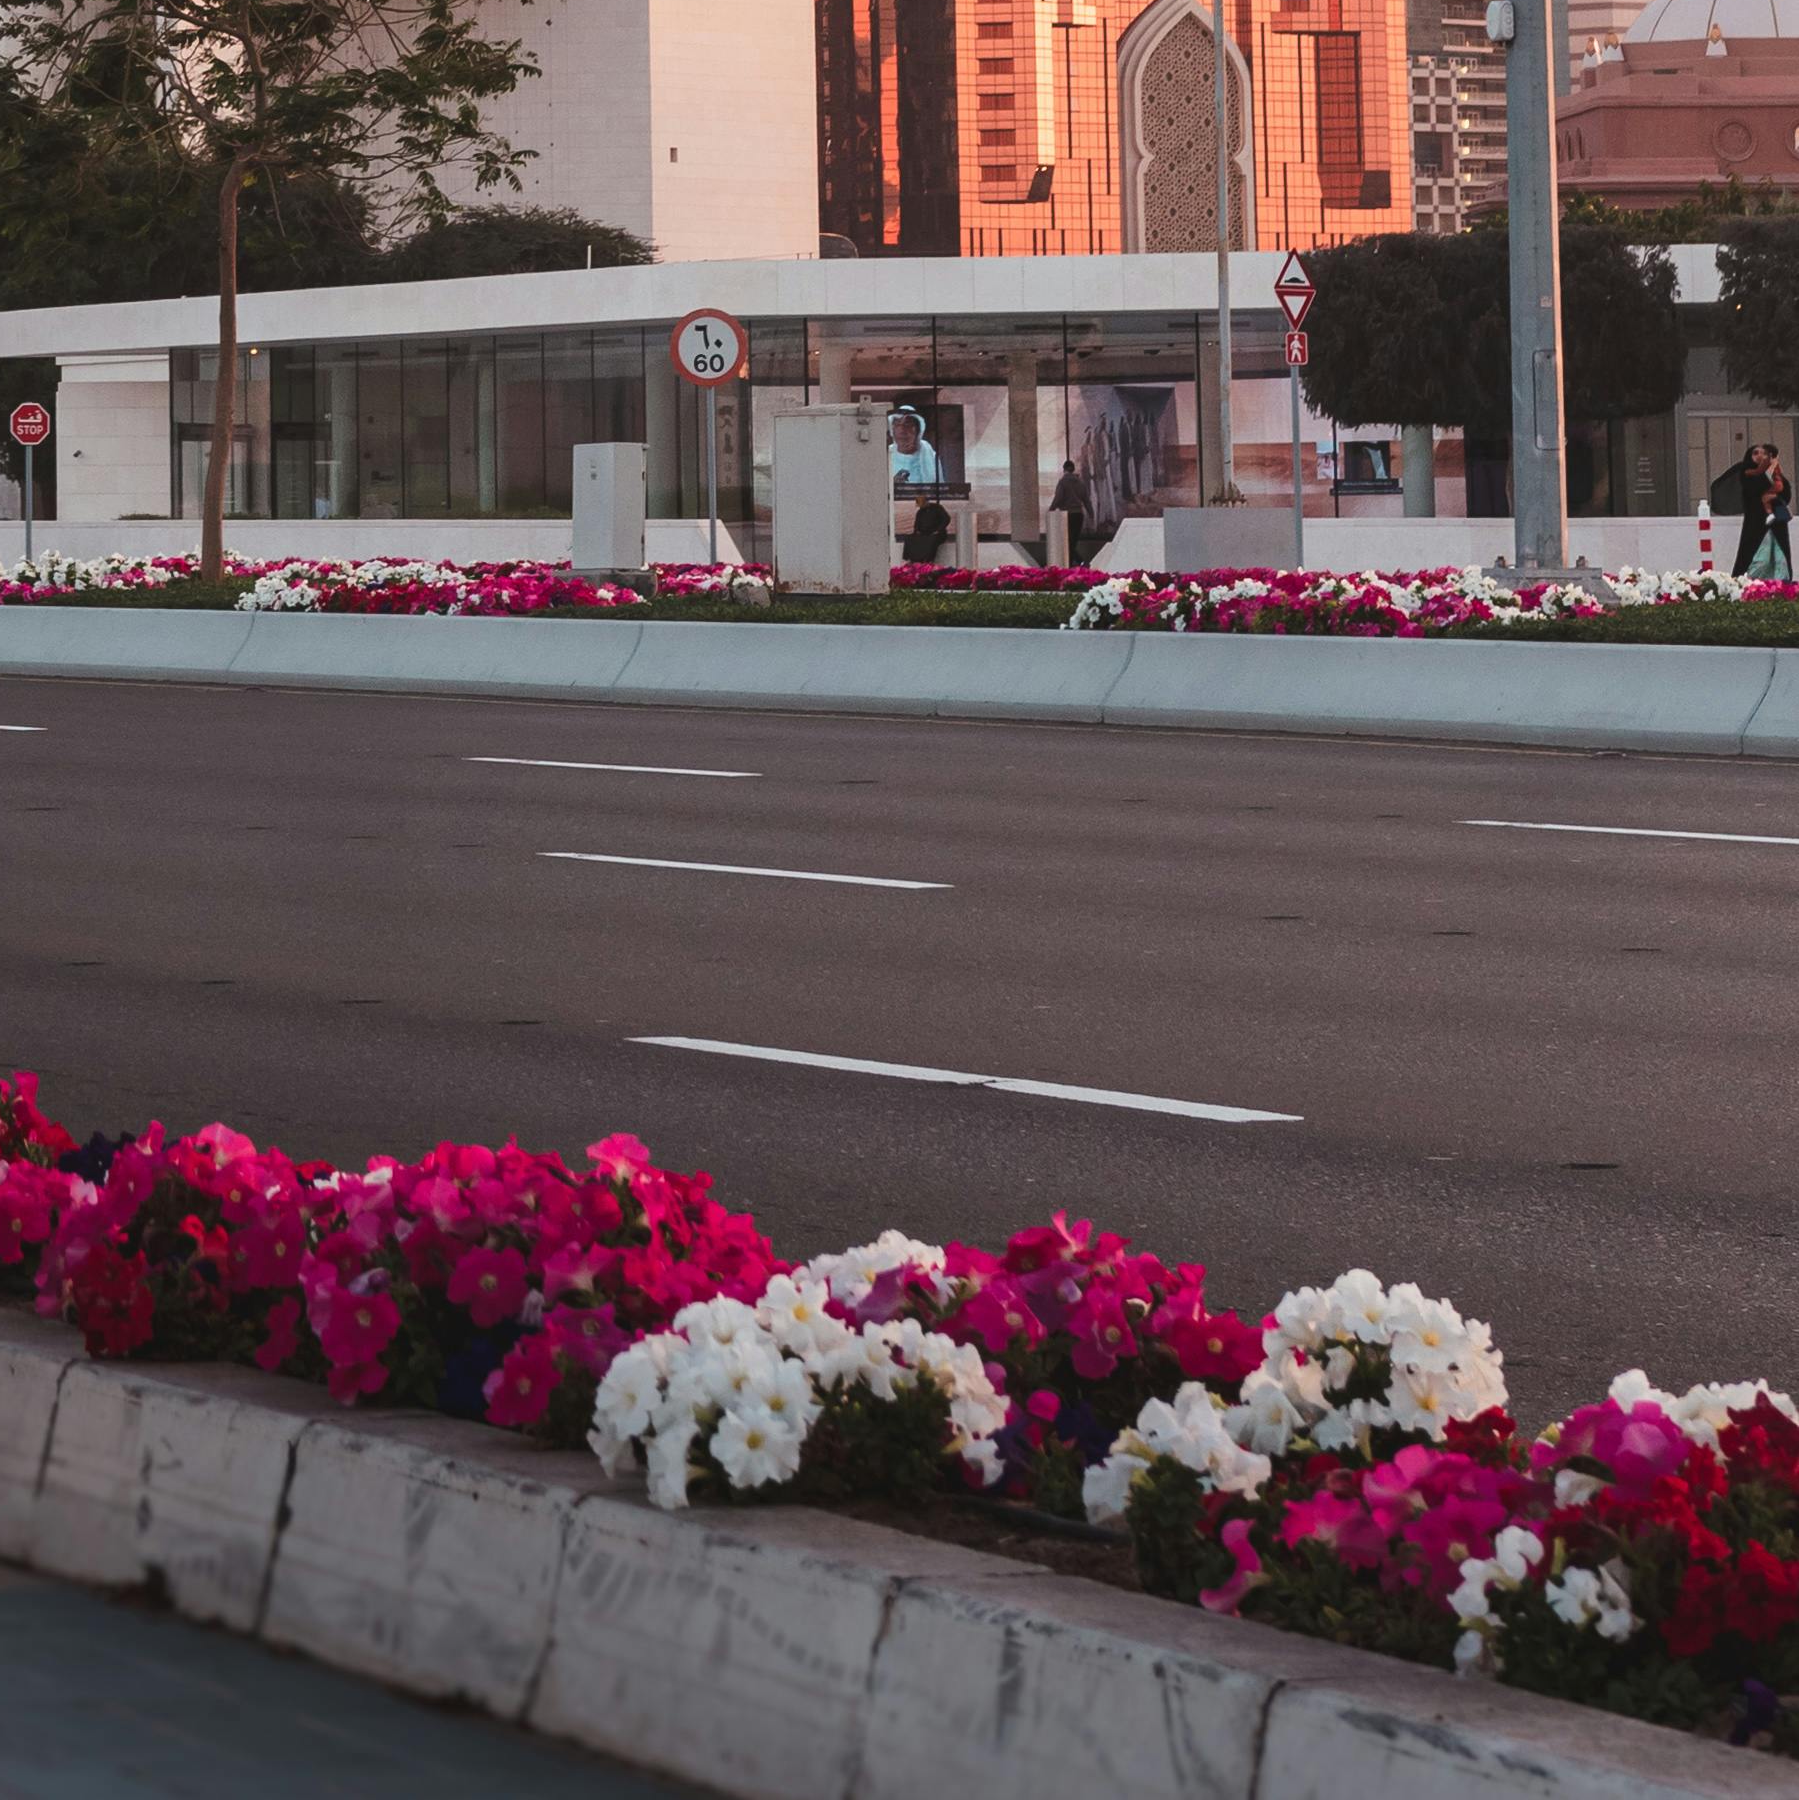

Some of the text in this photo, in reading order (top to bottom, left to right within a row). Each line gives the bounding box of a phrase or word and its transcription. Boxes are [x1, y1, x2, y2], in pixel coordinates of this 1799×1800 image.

[694, 354, 724, 372] 60
[18, 410, 42, 422] قف
[17, 425, 43, 435] STOP
